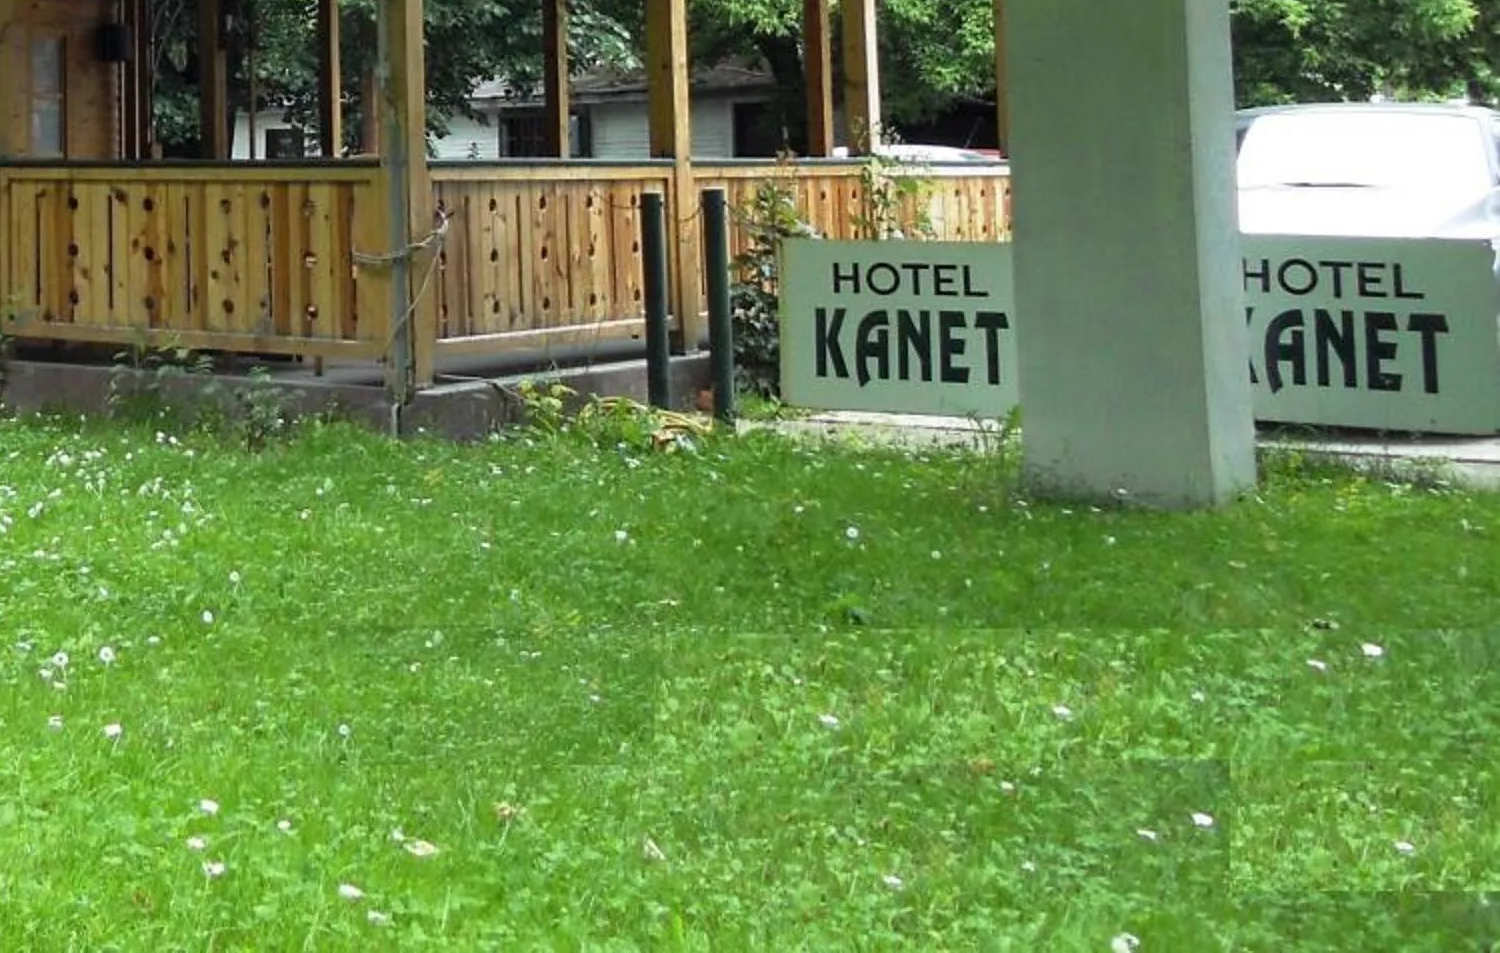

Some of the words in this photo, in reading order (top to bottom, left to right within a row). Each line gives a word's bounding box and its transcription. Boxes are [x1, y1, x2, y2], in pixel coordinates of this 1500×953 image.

[832, 262, 989, 298] HOTEL
[1241, 257, 1425, 299] HOTEL
[814, 307, 1010, 388] KANET
